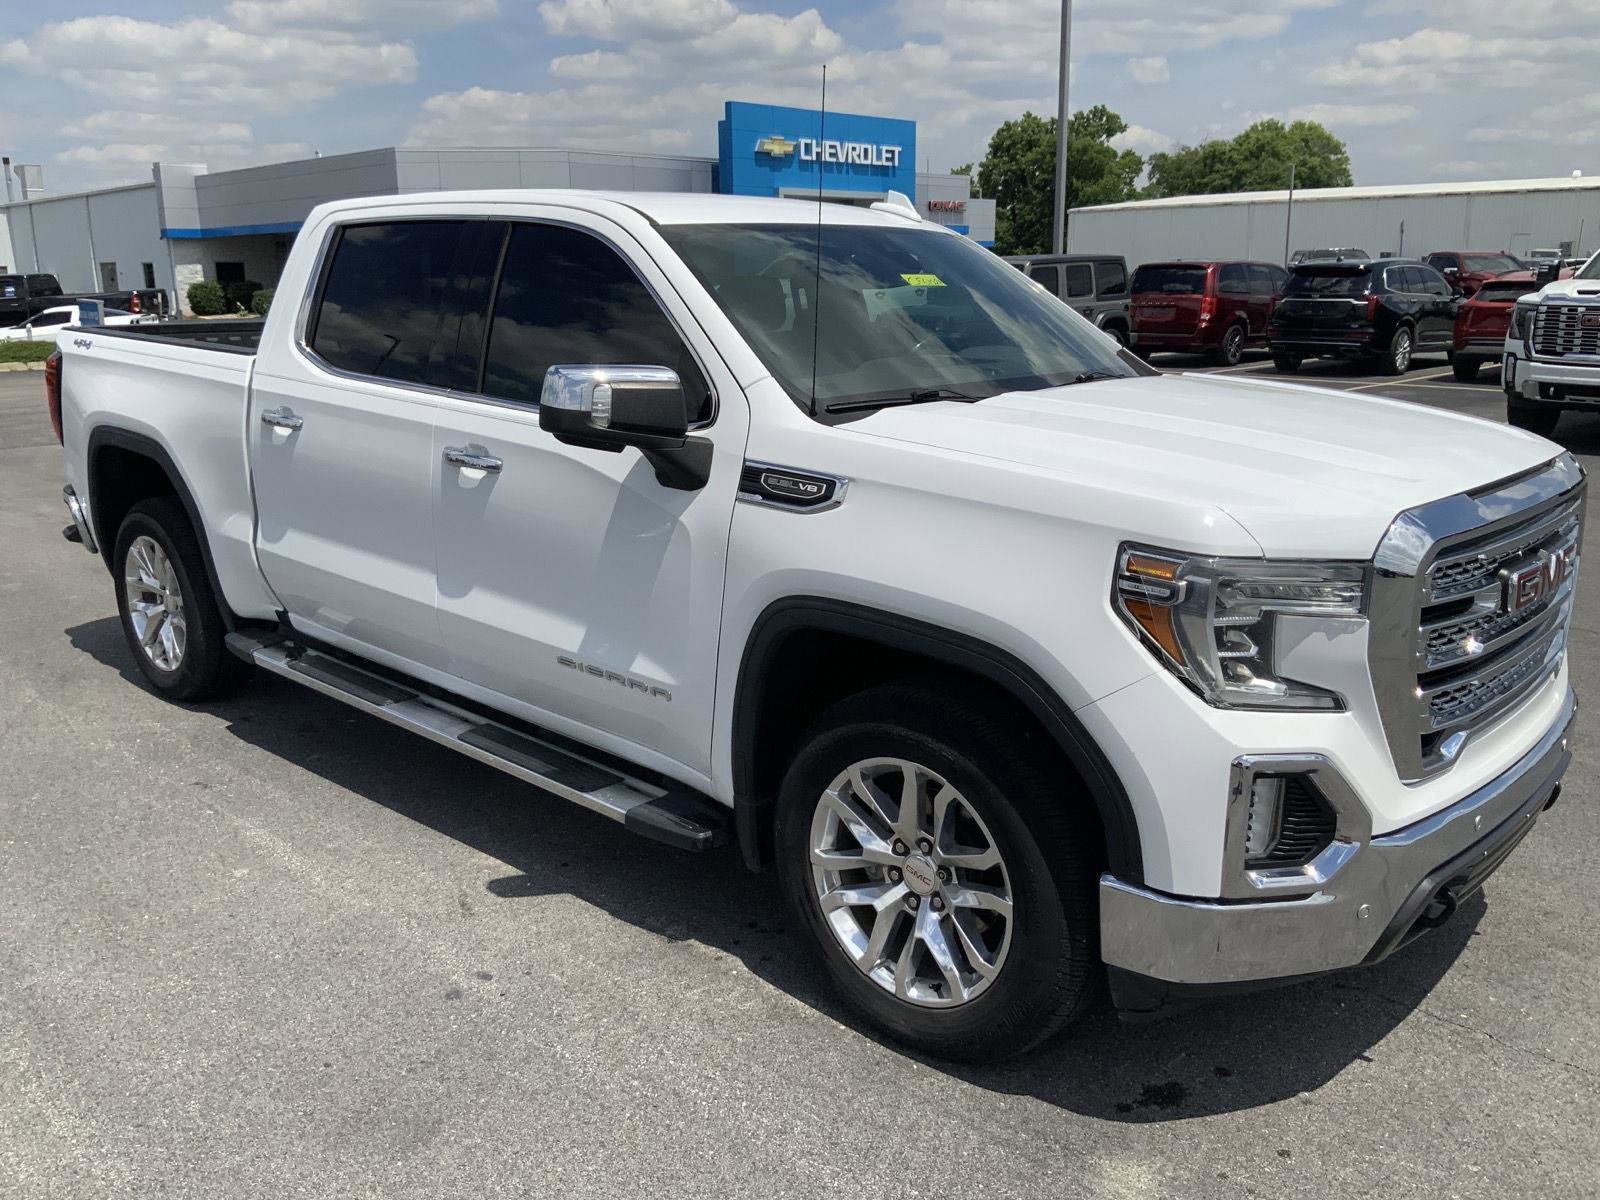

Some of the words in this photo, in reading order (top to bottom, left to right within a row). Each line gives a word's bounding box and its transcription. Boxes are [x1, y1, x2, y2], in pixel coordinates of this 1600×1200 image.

[799, 138, 902, 167] CHEVROLET
[929, 200, 967, 212] GMC
[798, 482, 818, 493] V8
[557, 655, 672, 702] SIERRA
[905, 864, 931, 886] GMC
